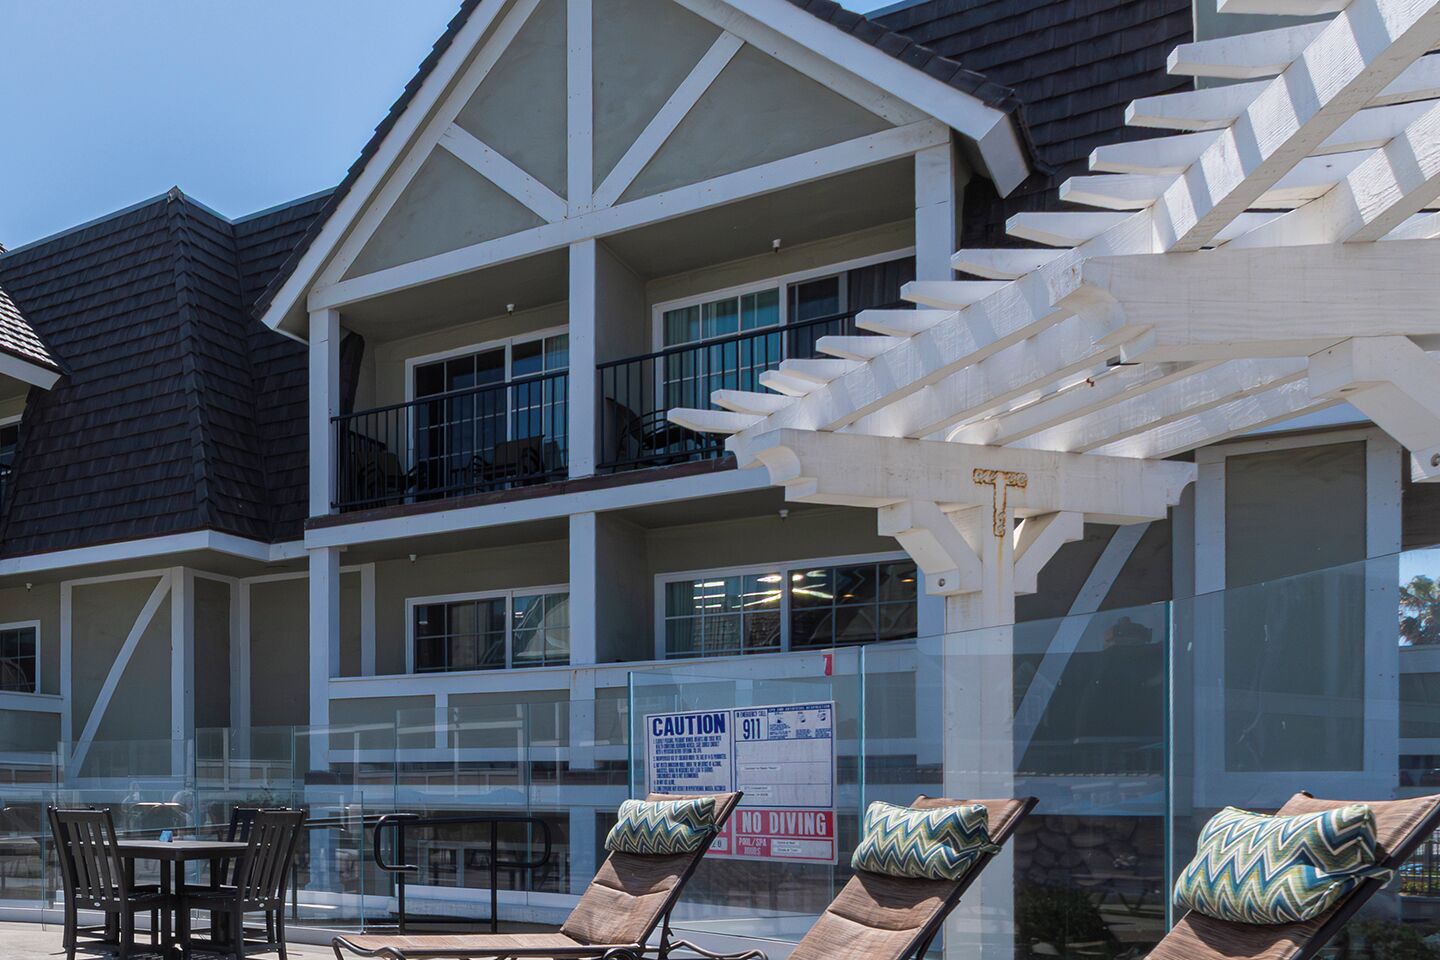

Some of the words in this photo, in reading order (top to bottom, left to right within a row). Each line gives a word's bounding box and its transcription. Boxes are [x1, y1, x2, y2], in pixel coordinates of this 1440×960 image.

[652, 713, 726, 737] CAUTION
[743, 718, 761, 740] 911
[742, 811, 762, 833] NO
[769, 812, 827, 836] DIVING
